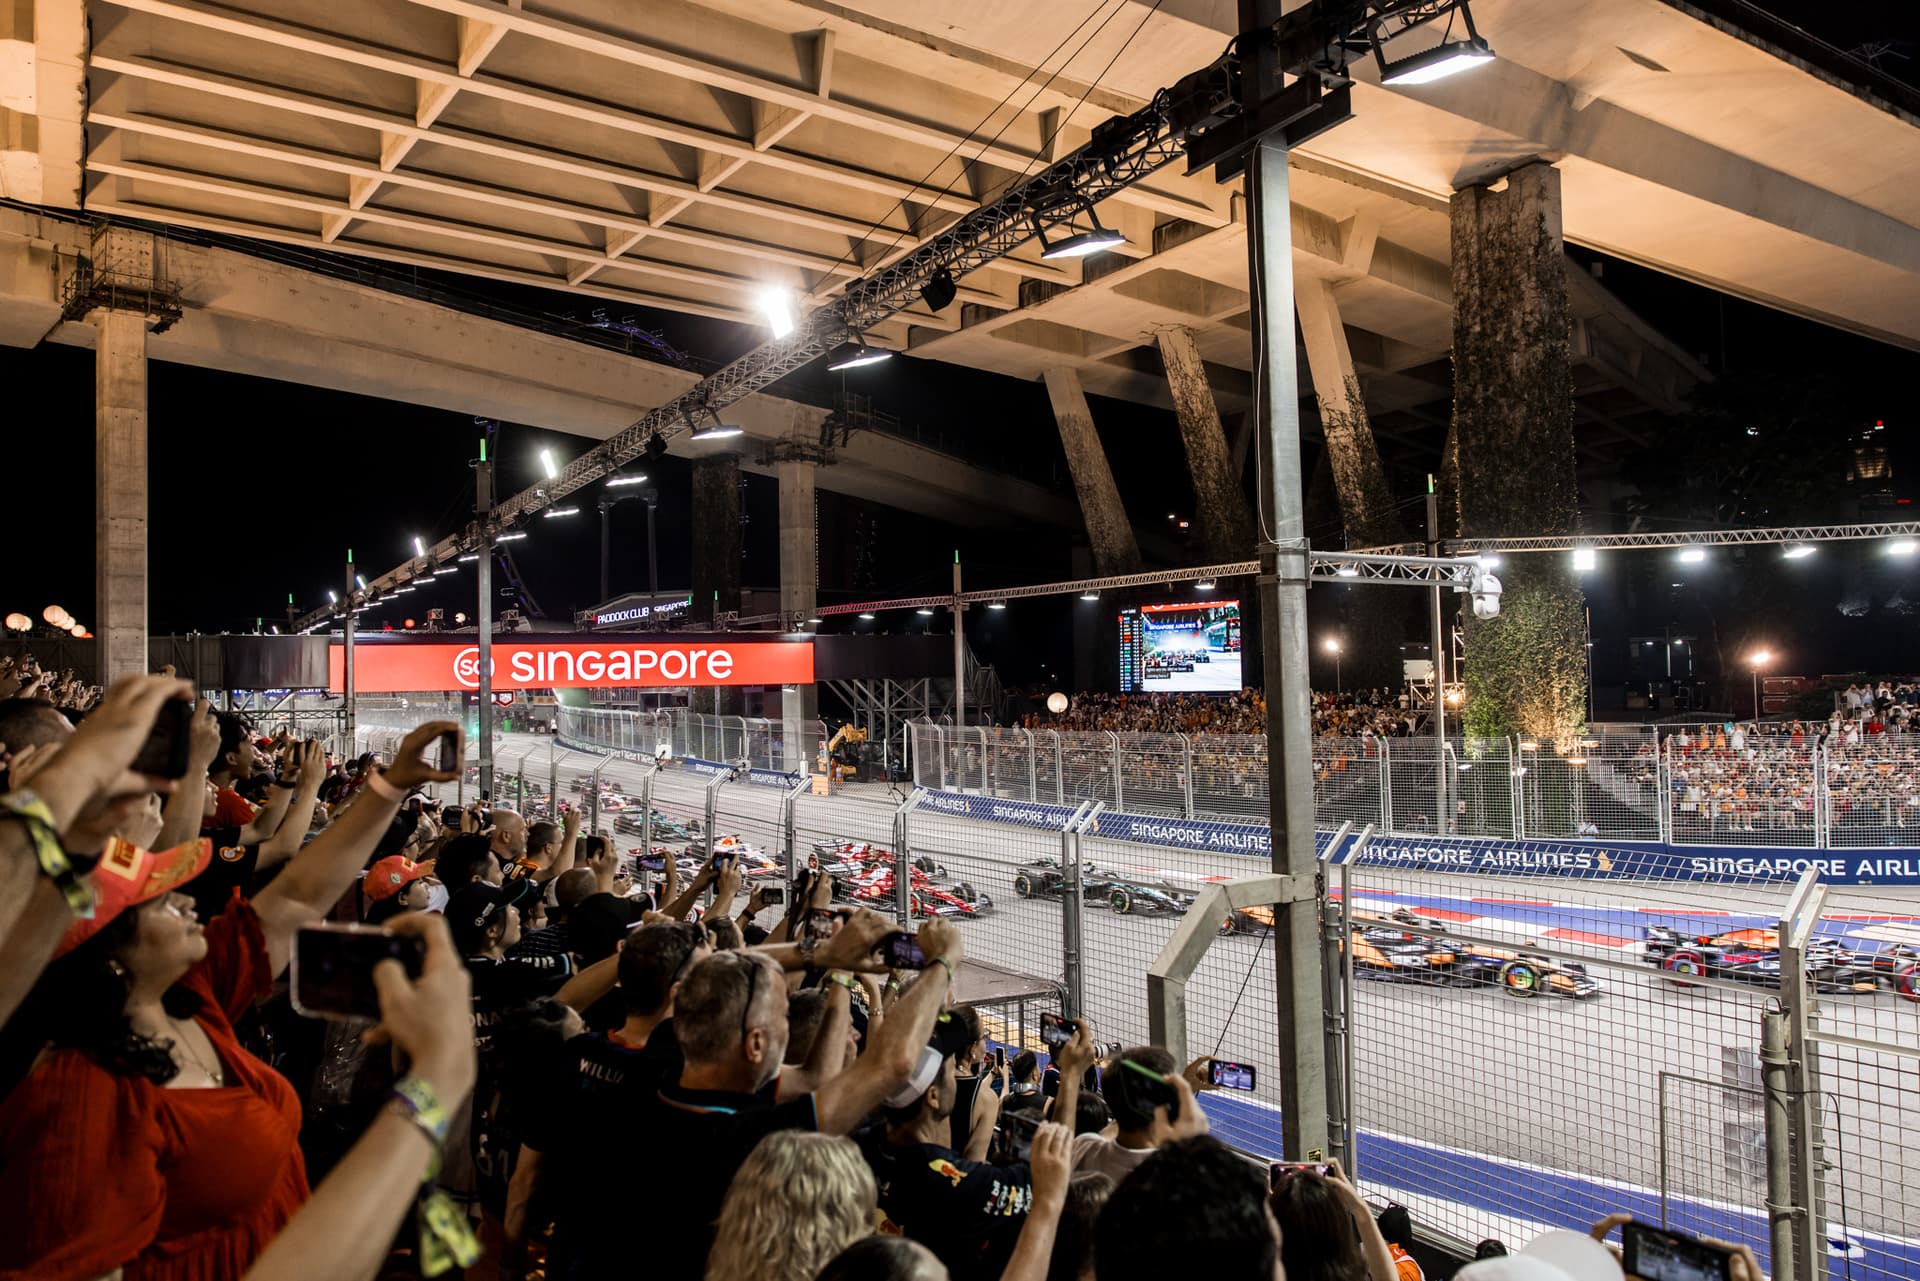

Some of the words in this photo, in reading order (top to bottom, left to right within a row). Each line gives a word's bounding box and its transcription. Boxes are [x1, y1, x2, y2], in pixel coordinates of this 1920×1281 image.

[597, 610, 629, 624] PADDOCK
[630, 607, 649, 618] CLUB
[993, 806, 1043, 824] SINGAPORE
[1131, 823, 1204, 843] SINGAPORE
[1481, 850, 1592, 869] AIRLINES
[1691, 857, 1846, 876] SINGAPORE
